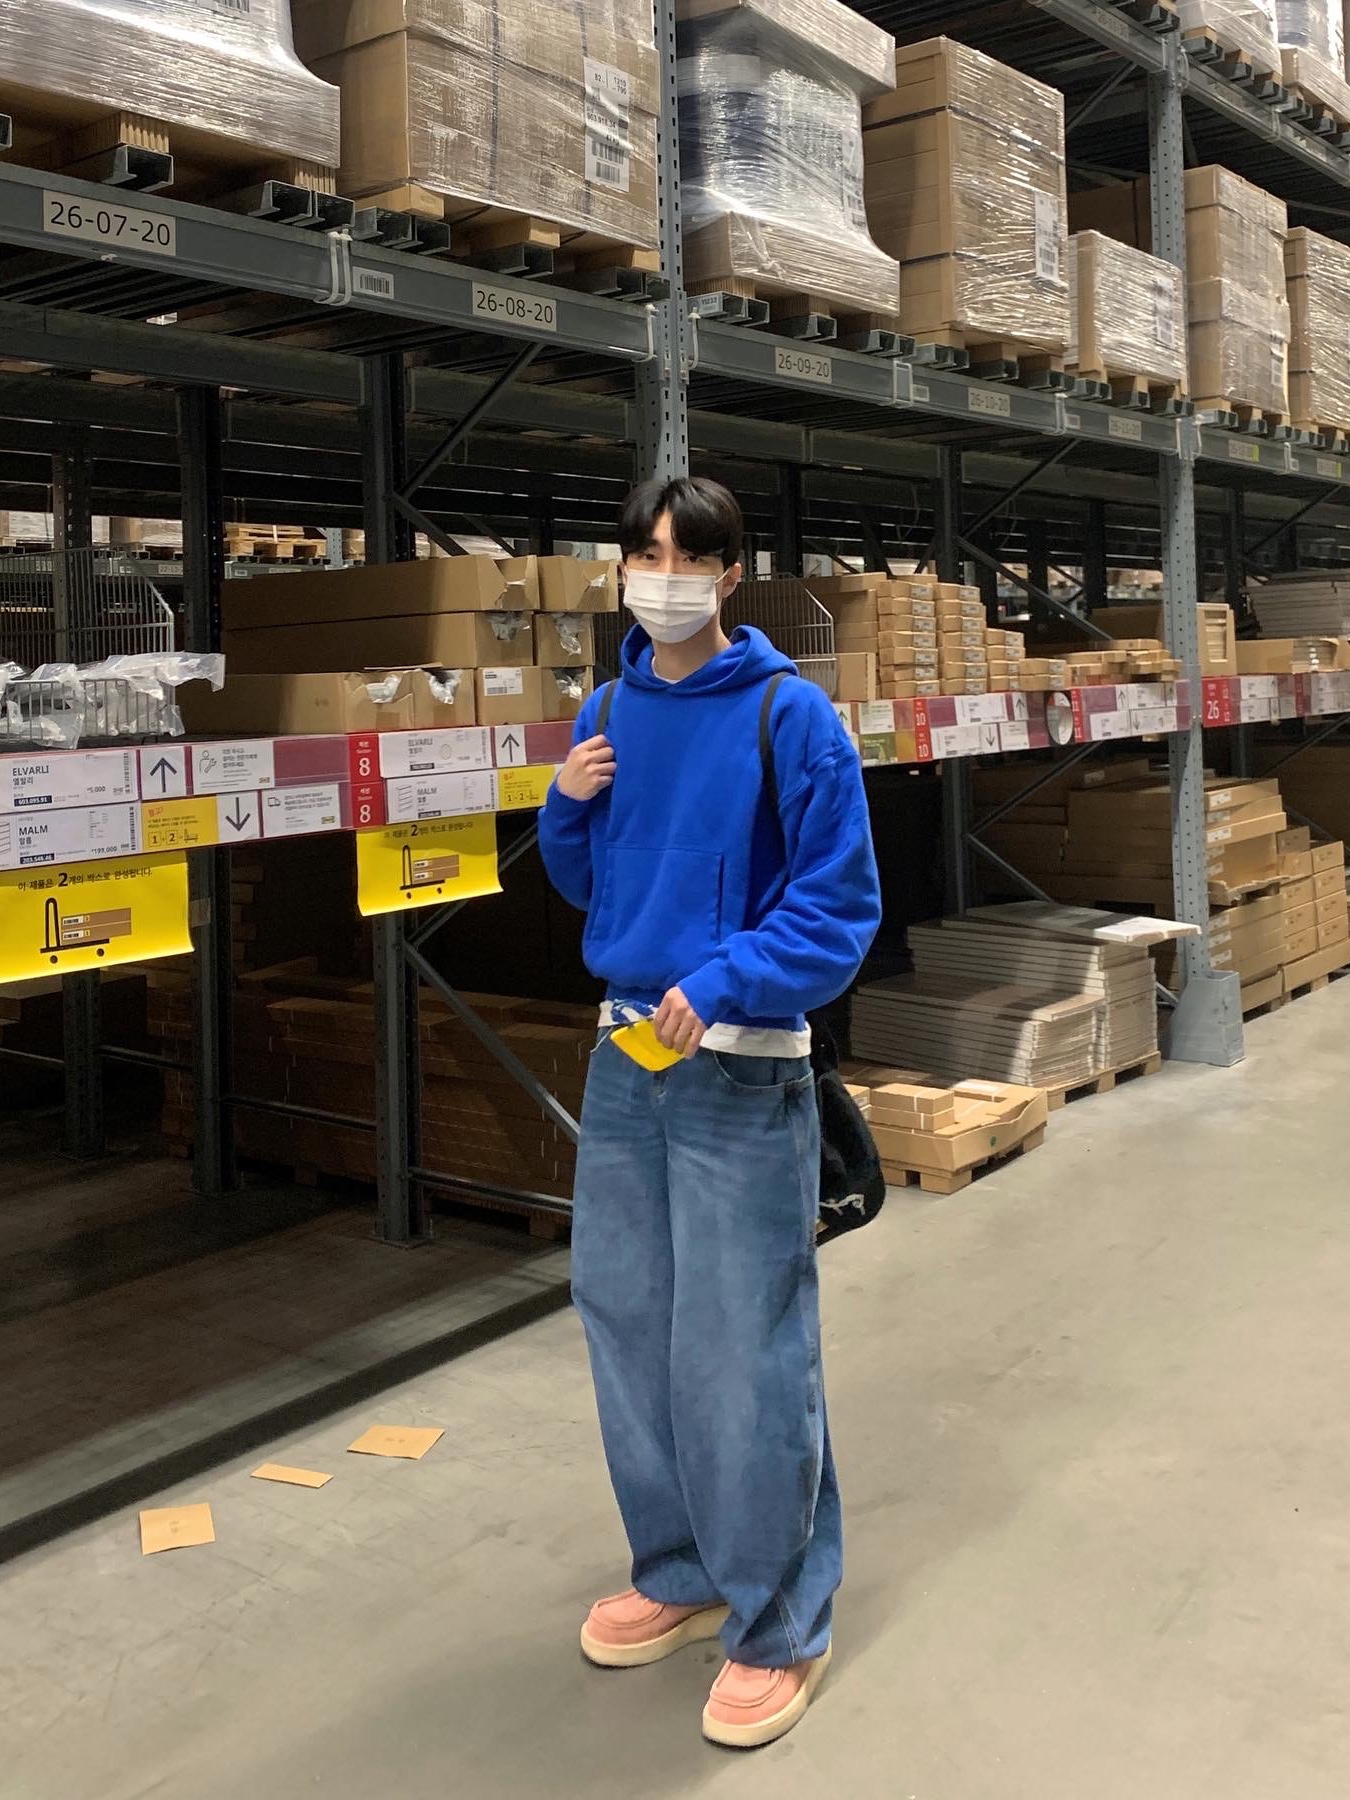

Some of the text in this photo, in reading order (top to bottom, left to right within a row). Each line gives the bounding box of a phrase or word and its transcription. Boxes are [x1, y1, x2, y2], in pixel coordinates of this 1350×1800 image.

[50, 201, 171, 246] 26-07-20
[476, 290, 554, 324] 26-08-20
[778, 353, 830, 378] 26-09-20
[1206, 700, 1220, 720] 26
[12, 765, 49, 776] ELVARLI
[359, 757, 371, 777] 8
[359, 804, 371, 824] 8
[18, 825, 48, 836] MALM
